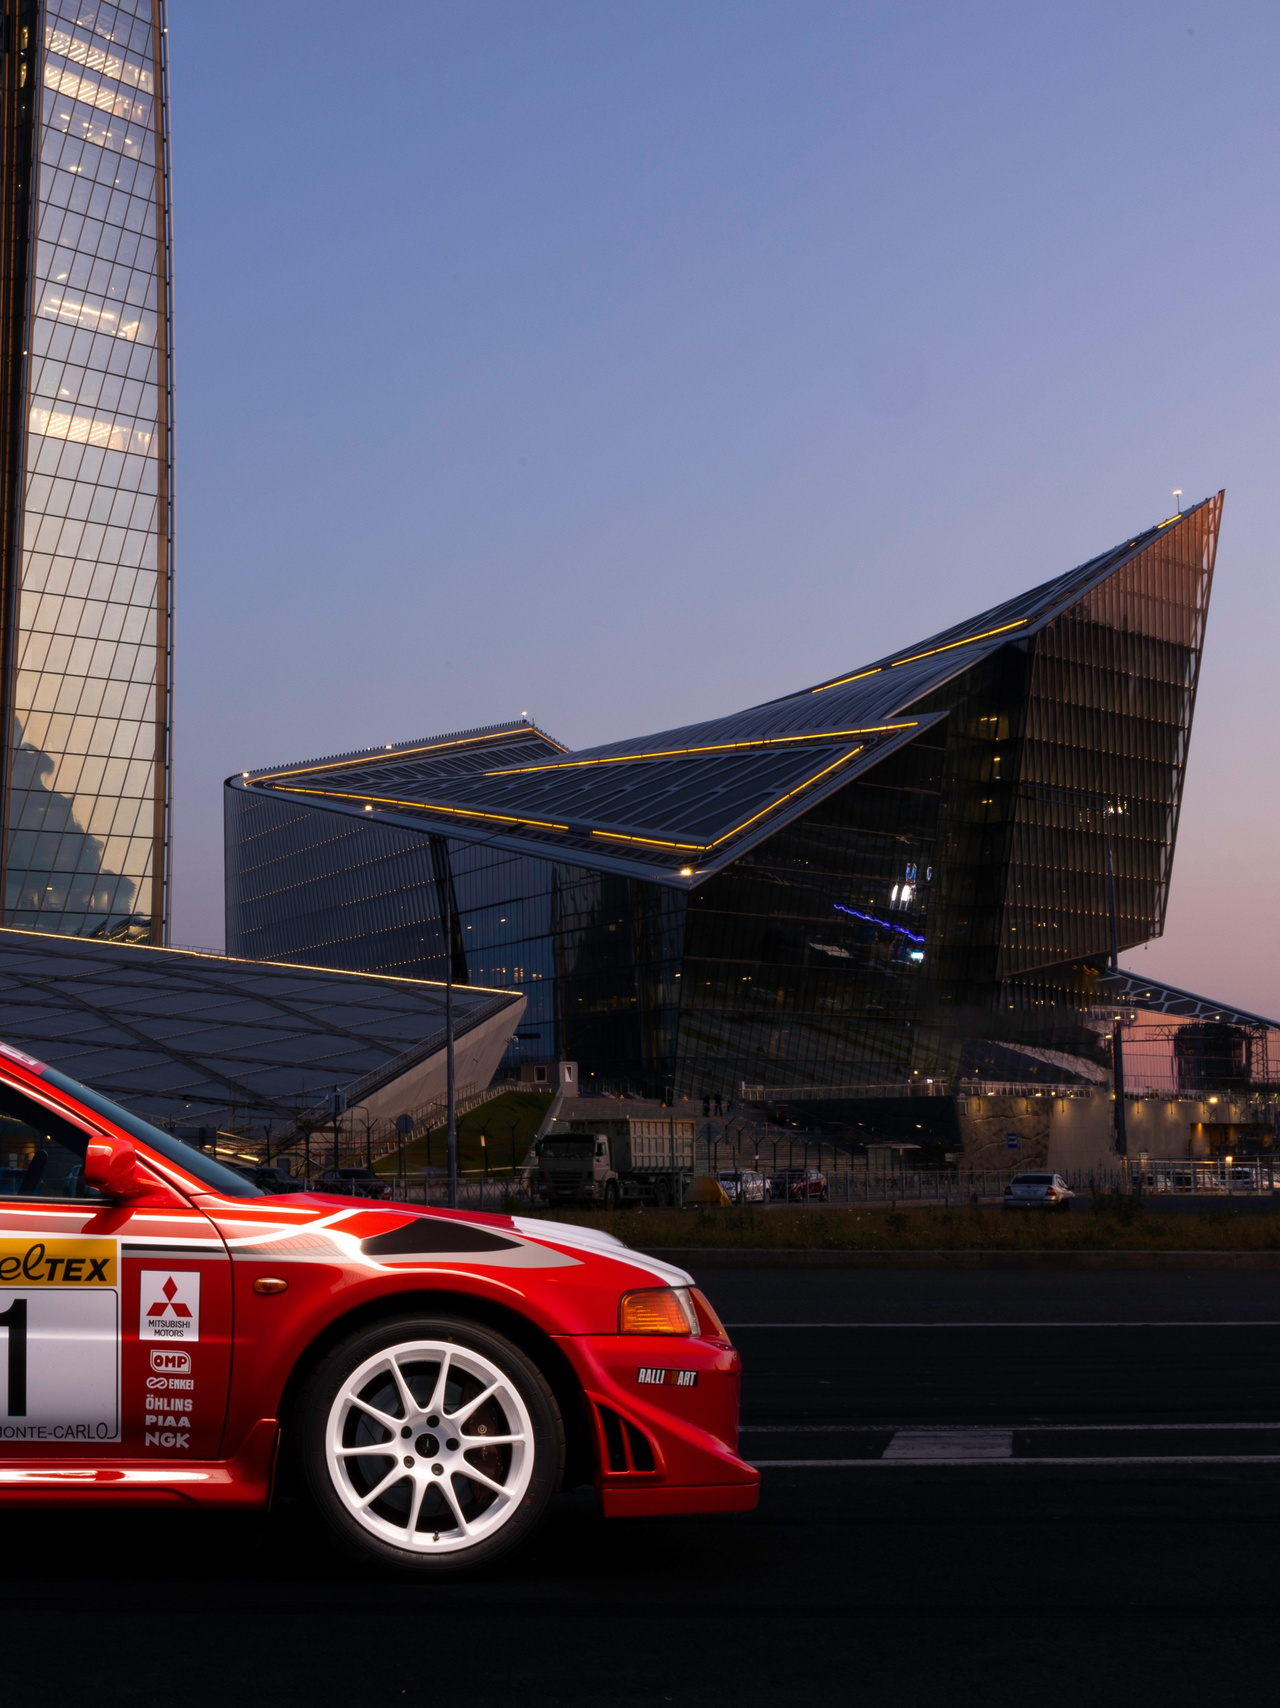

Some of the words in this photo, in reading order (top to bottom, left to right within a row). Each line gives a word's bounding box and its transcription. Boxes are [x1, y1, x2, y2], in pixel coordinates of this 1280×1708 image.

[148, 1319, 191, 1329] MITSUBISHI
[153, 1328, 184, 1337] MOTORS
[153, 1354, 188, 1368] OMP
[168, 1378, 194, 1391] ENKEI
[637, 1368, 666, 1385] RALLI
[676, 1371, 697, 1387] ART
[145, 1393, 193, 1412] ÖHLINS
[145, 1414, 192, 1428] PIAA
[144, 1431, 191, 1449] NGK
